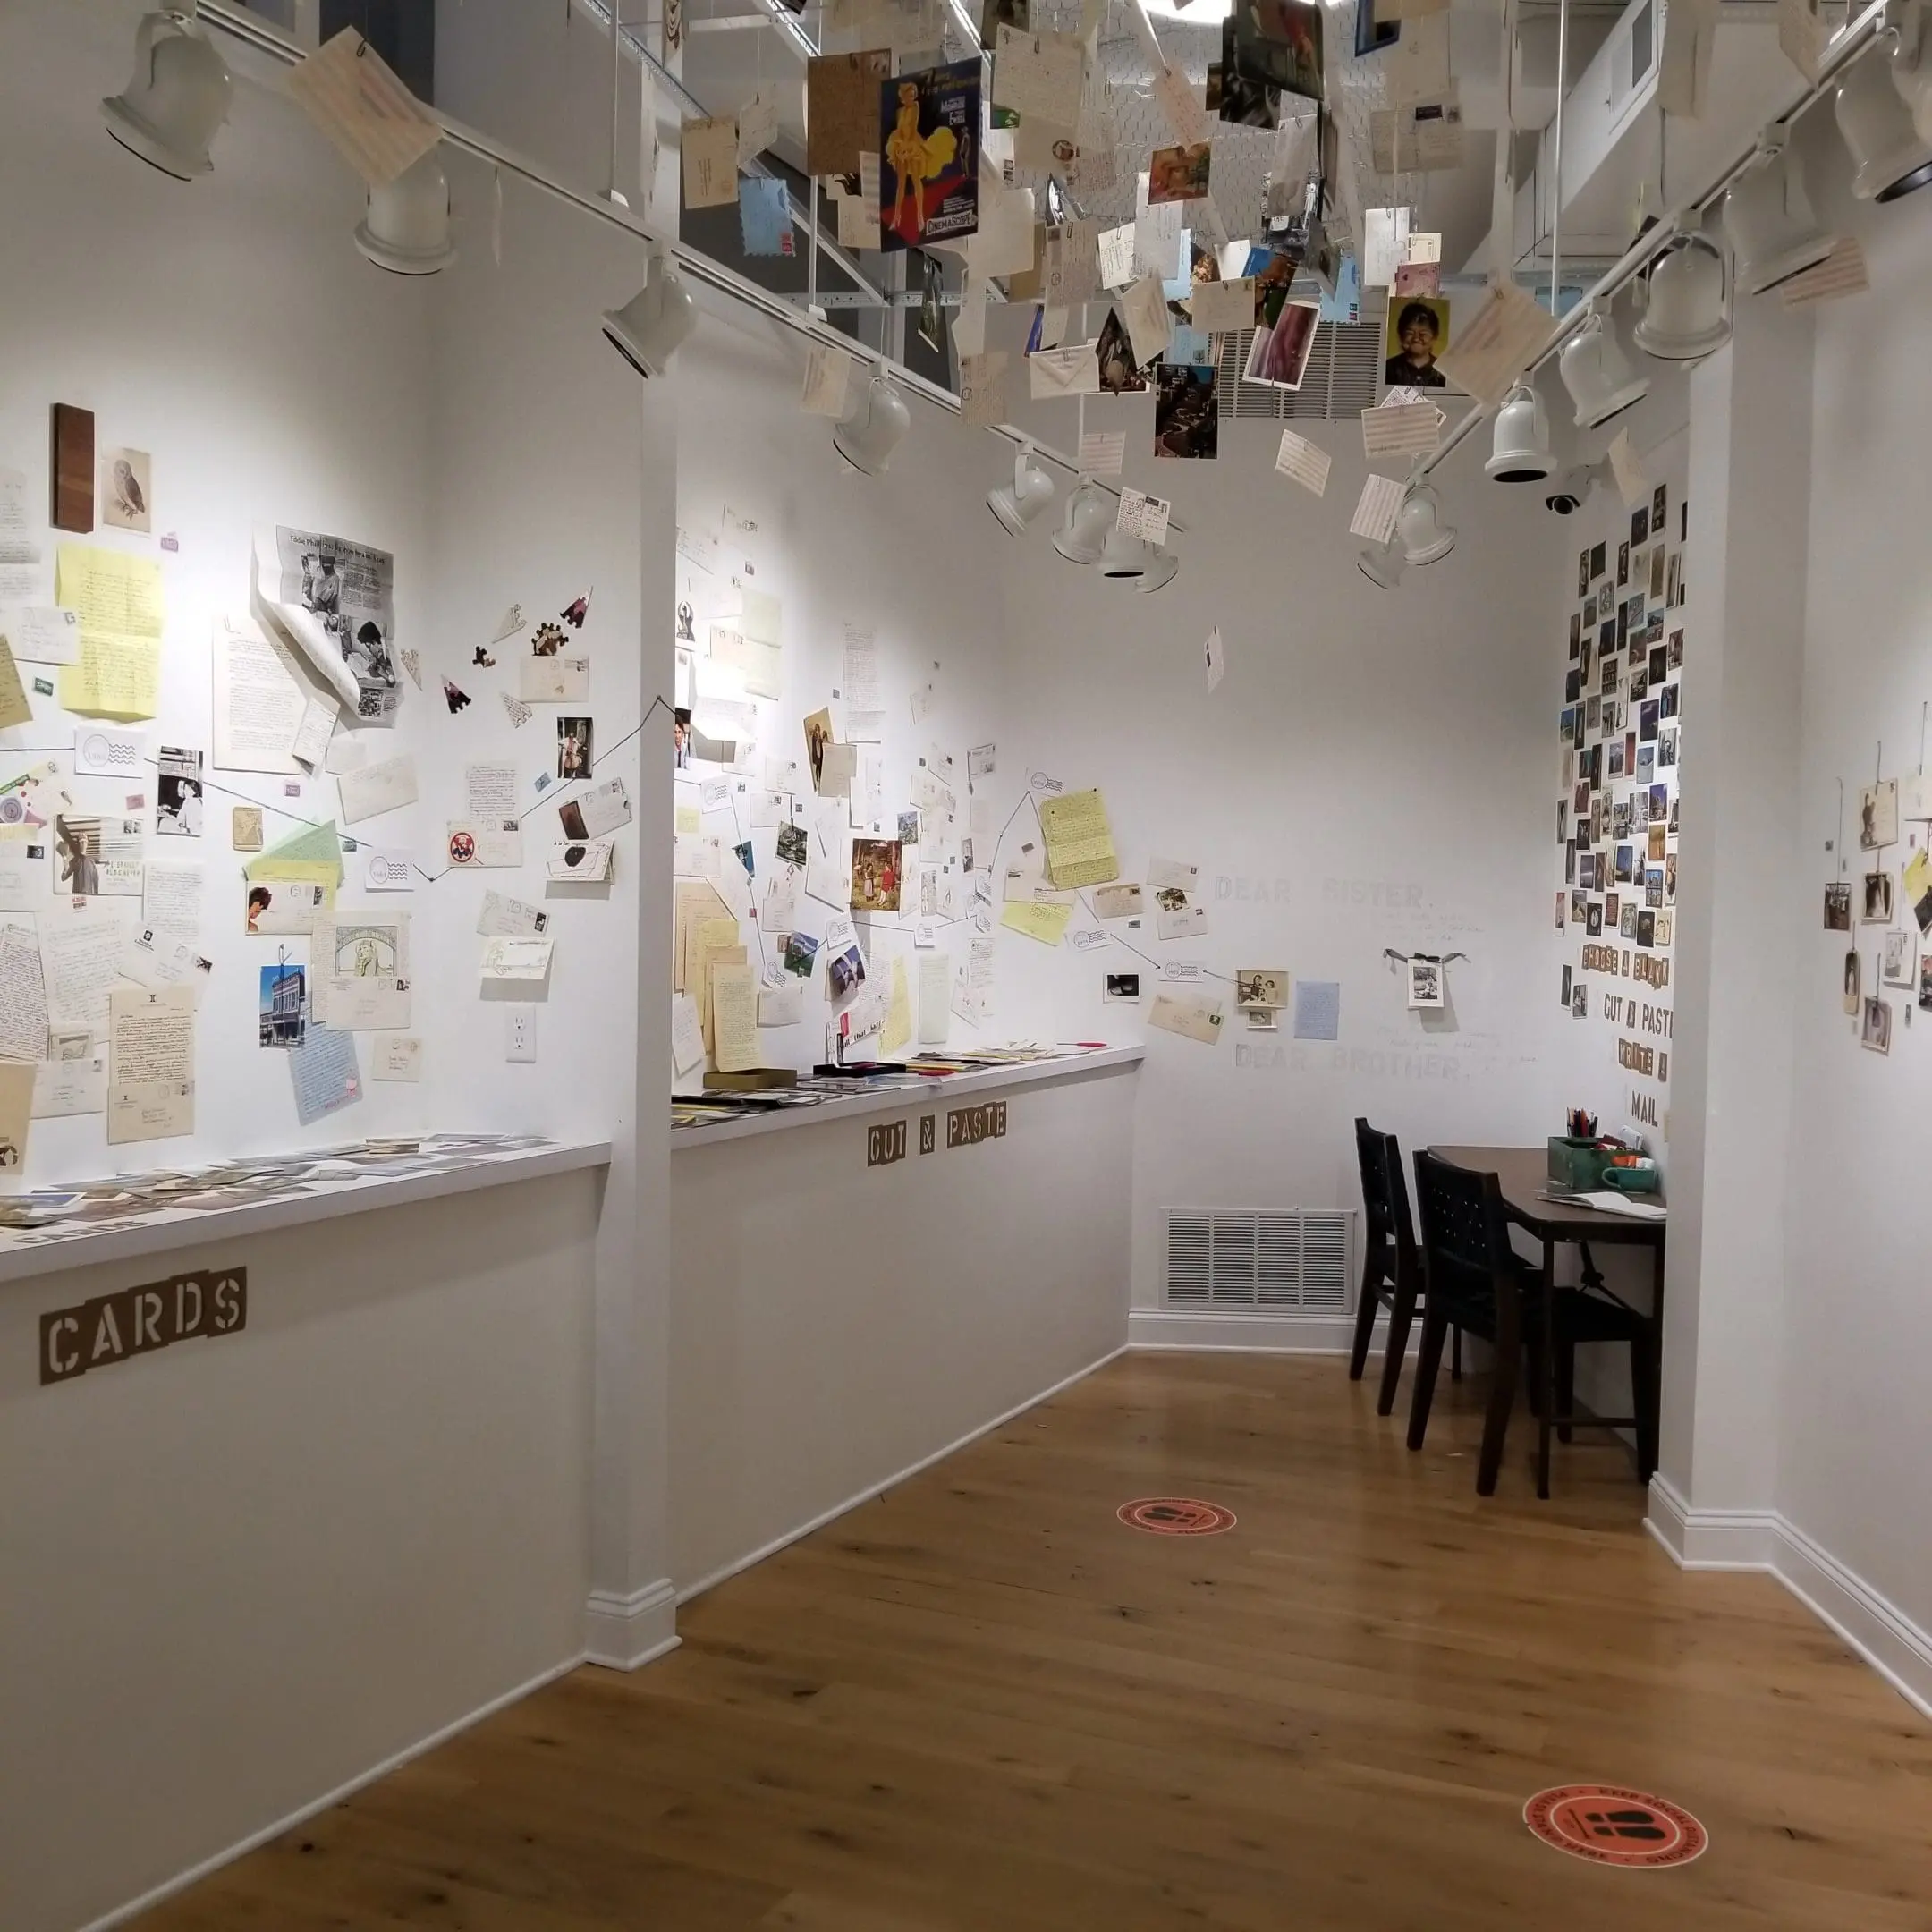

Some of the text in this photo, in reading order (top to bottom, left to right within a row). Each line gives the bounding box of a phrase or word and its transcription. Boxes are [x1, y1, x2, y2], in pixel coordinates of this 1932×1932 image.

[1214, 876, 1292, 903] DEAR
[1583, 946, 1617, 973] CHOOSE
[1634, 955, 1668, 987] BLANK
[1604, 993, 1623, 1022] CUT
[1234, 1043, 1307, 1072] DEAR
[1619, 1040, 1653, 1073] WRITE
[1631, 1090, 1658, 1127] MAIL
[869, 1104, 1005, 1164] CUT & PASTE
[46, 1273, 242, 1378] CARDS
